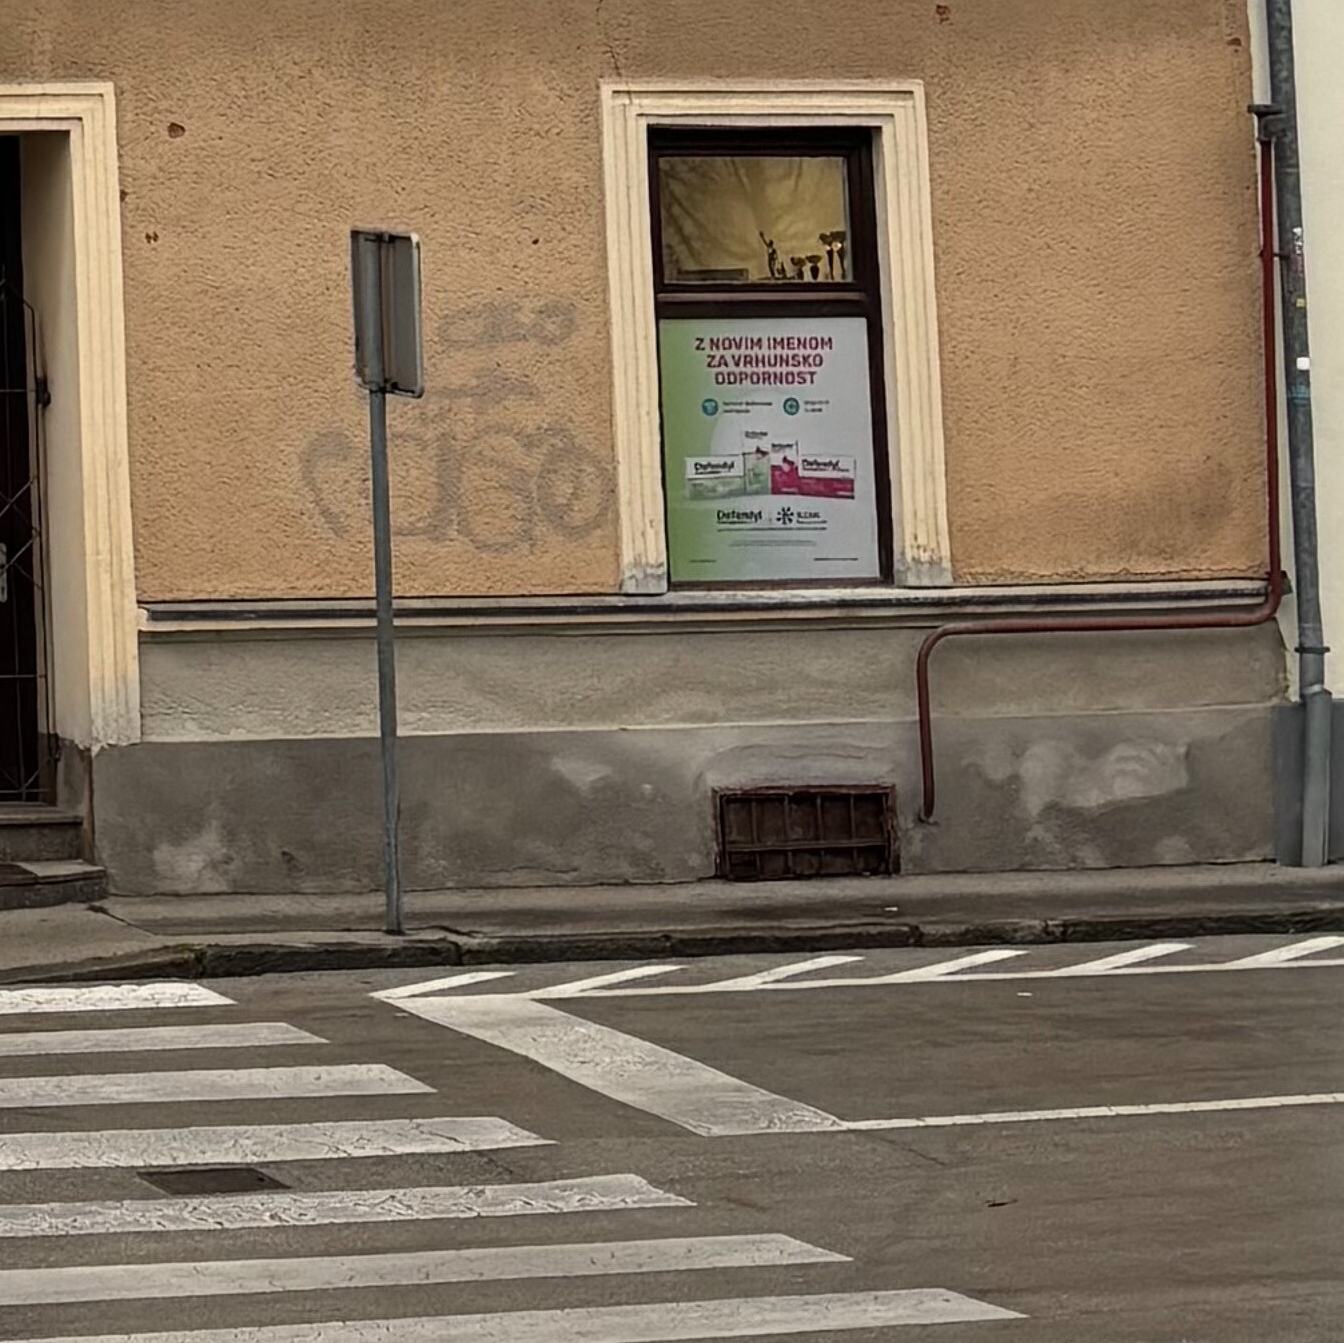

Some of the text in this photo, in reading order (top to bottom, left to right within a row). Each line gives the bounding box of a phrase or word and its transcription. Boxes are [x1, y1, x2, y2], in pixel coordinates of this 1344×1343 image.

[695, 336, 834, 351] Z NOVIM IMENOM
[707, 353, 824, 368] ZA VRHUNSKO
[715, 371, 817, 386] ODPORNOST
